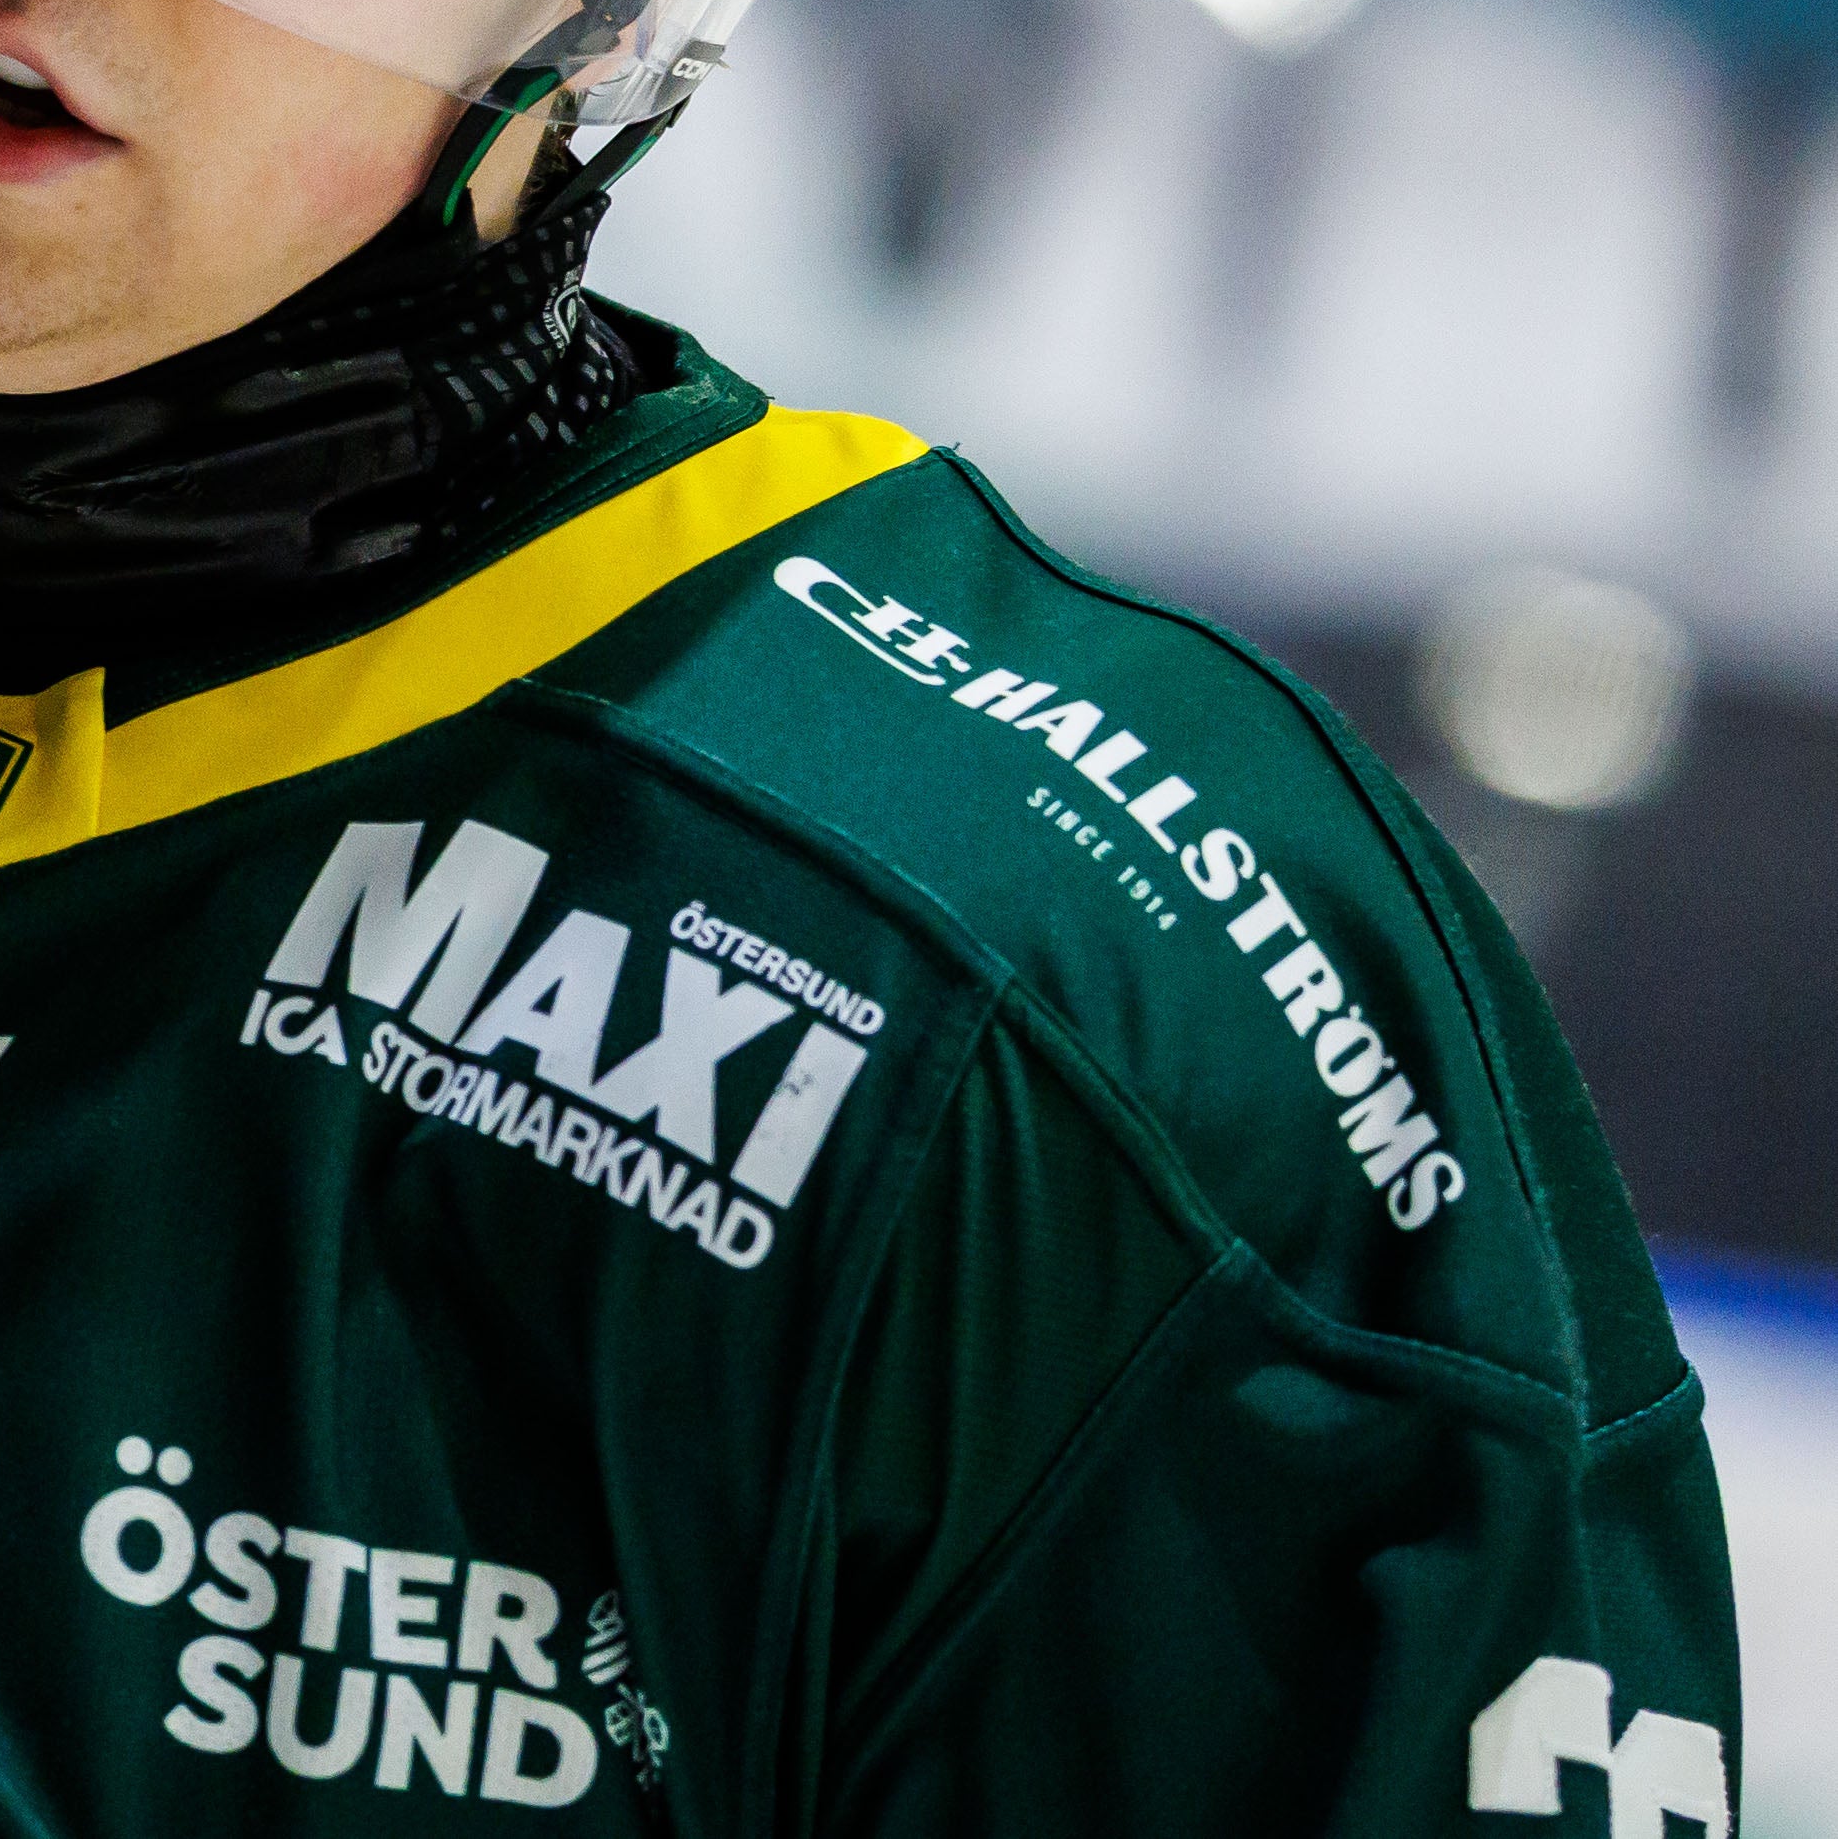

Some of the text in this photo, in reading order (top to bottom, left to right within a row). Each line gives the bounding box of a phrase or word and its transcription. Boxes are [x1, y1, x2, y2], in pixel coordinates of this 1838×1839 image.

[669, 898, 886, 1037] ÖSTERSUND
[949, 666, 1467, 1232] HALLSTRÖMS
[1026, 786, 1178, 931] SINCE 1914
[239, 988, 776, 1271] ICA STORMARKNAD
[264, 818, 869, 1210] MAXI
[79, 1434, 562, 1690] ÖSTER
[162, 1634, 600, 1809] SUND
